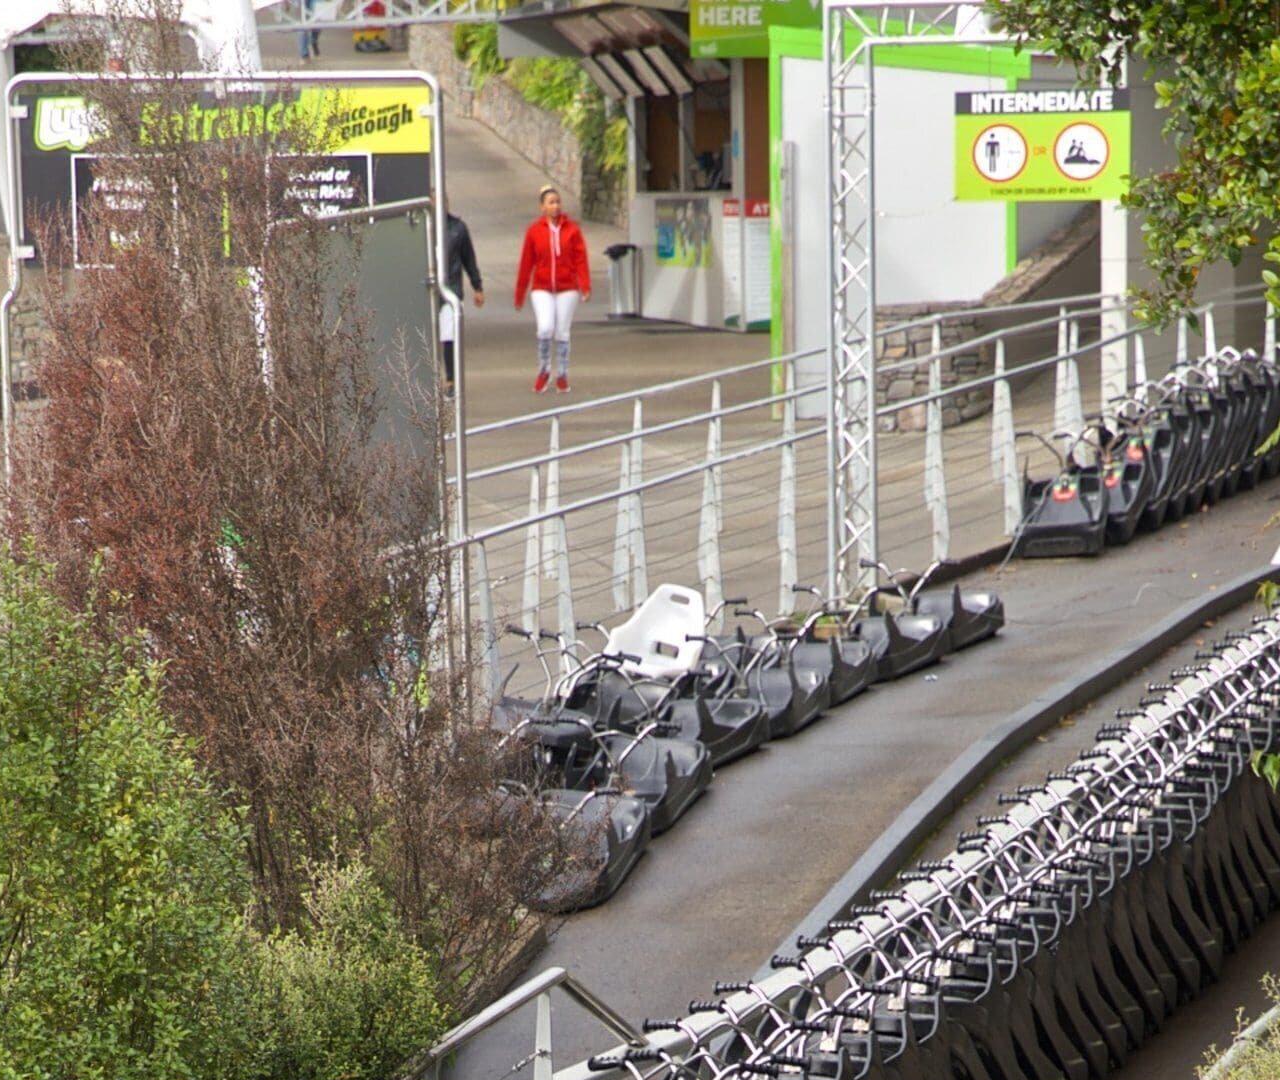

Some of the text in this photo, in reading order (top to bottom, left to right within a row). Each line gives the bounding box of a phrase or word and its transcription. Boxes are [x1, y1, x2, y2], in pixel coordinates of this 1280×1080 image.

[698, 5, 762, 26] HERE
[971, 91, 1113, 113] INTERMEDIATE
[340, 104, 413, 140] enough
[1032, 146, 1047, 156] OR
